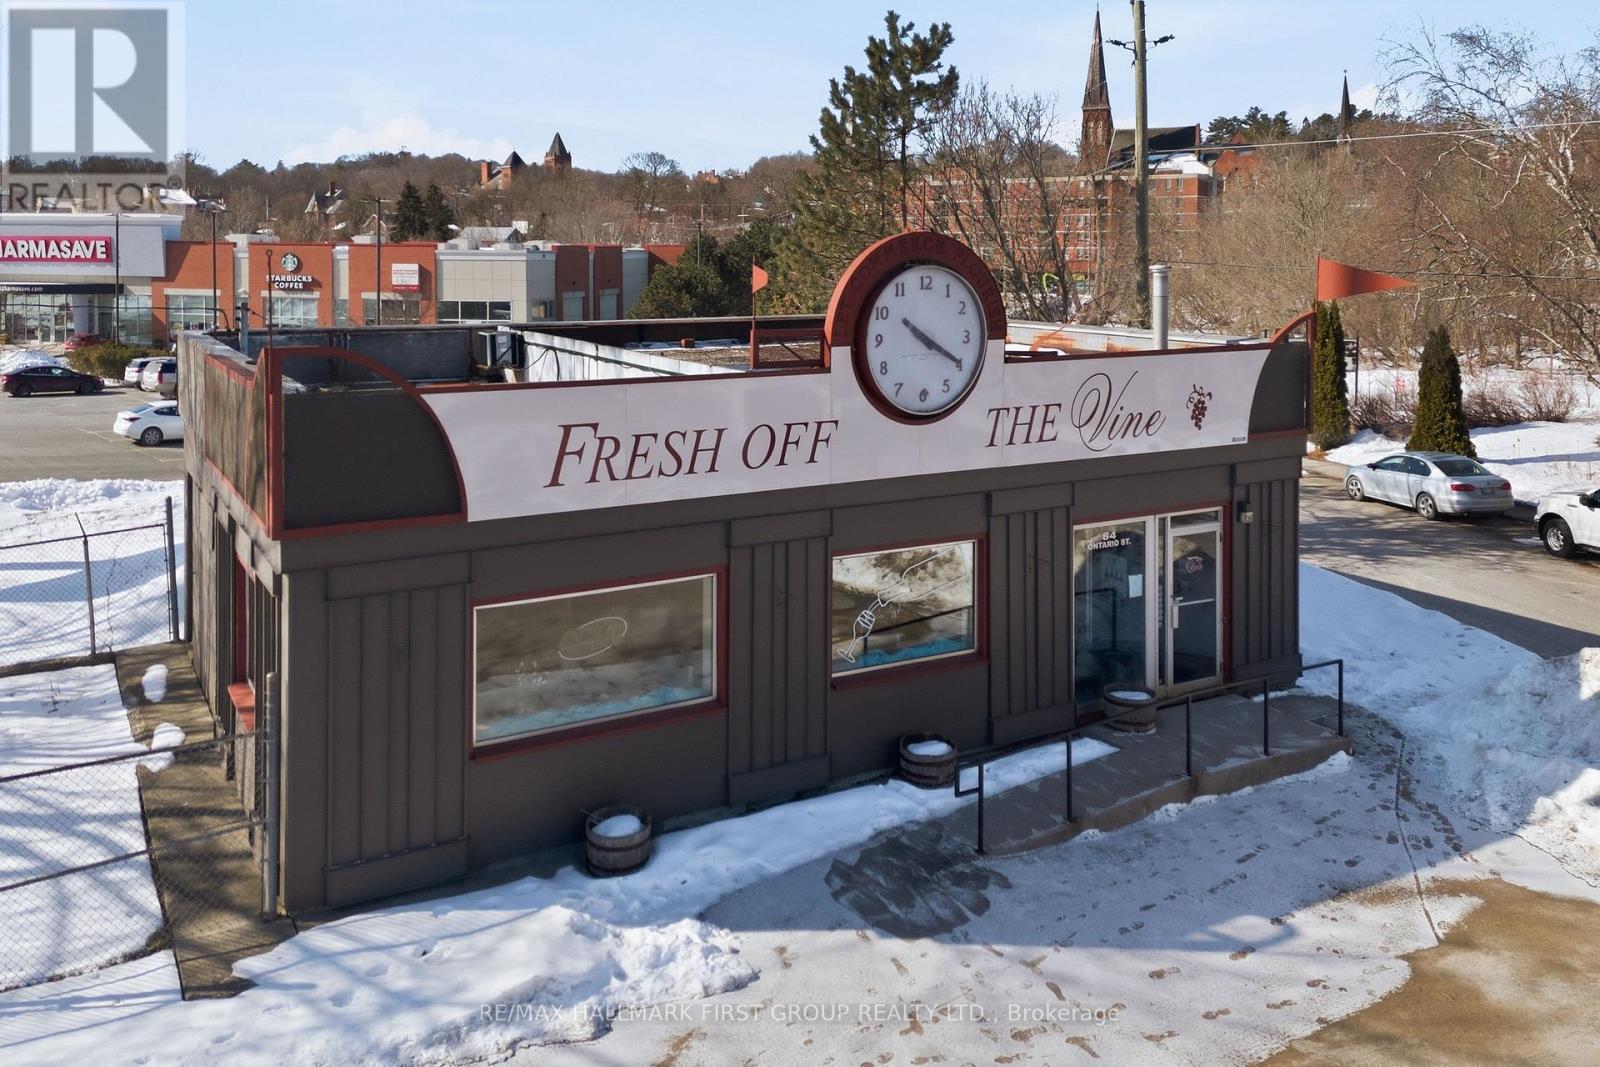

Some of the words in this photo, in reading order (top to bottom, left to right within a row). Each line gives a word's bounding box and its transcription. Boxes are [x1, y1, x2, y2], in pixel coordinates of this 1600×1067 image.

[0, 239, 107, 260] ARMASAVE
[894, 282, 905, 297] 11
[919, 275, 933, 291] 12
[944, 283, 951, 298] 1
[874, 305, 889, 321] 10
[958, 300, 967, 315] 2
[874, 333, 884, 349] 9
[962, 329, 971, 344] 3
[879, 360, 889, 376] 8
[894, 382, 904, 398] 7
[941, 379, 951, 393] 5
[543, 421, 728, 489] FRESH
[741, 419, 839, 471] OFF
[985, 402, 1063, 448] THE
[1070, 370, 1167, 452] Vine
[1102, 531, 1117, 541] 84
[1087, 539, 1120, 551] ONTARIO
[1120, 537, 1132, 546] ST.
